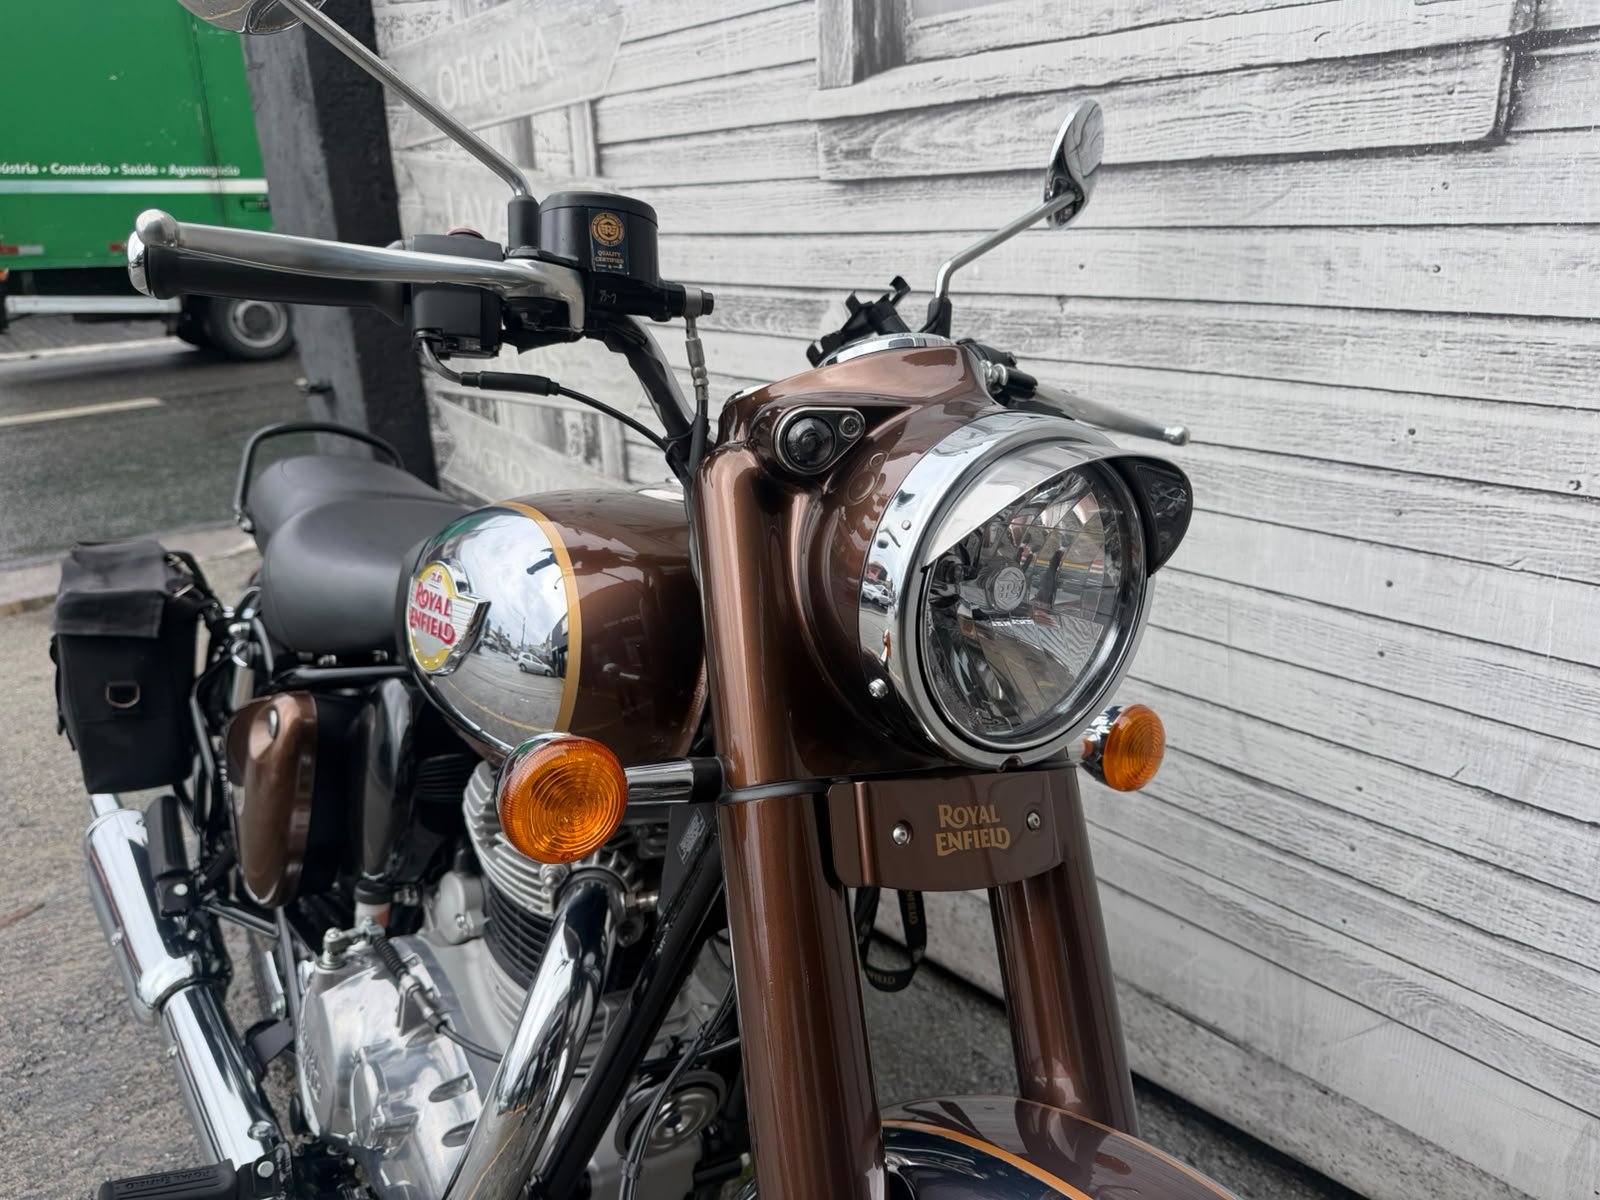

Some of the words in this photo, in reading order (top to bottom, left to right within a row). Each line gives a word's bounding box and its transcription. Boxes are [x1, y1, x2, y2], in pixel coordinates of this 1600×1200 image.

[437, 26, 556, 111] OFICINA
[50, 161, 111, 175] Comércio
[120, 161, 159, 175] Saúde
[597, 249, 621, 257] QUALITY
[415, 582, 450, 617] ROYAL
[409, 606, 455, 645] ENFIELD
[937, 803, 1000, 828] ROYAL
[935, 826, 1011, 857] ENFIELD
